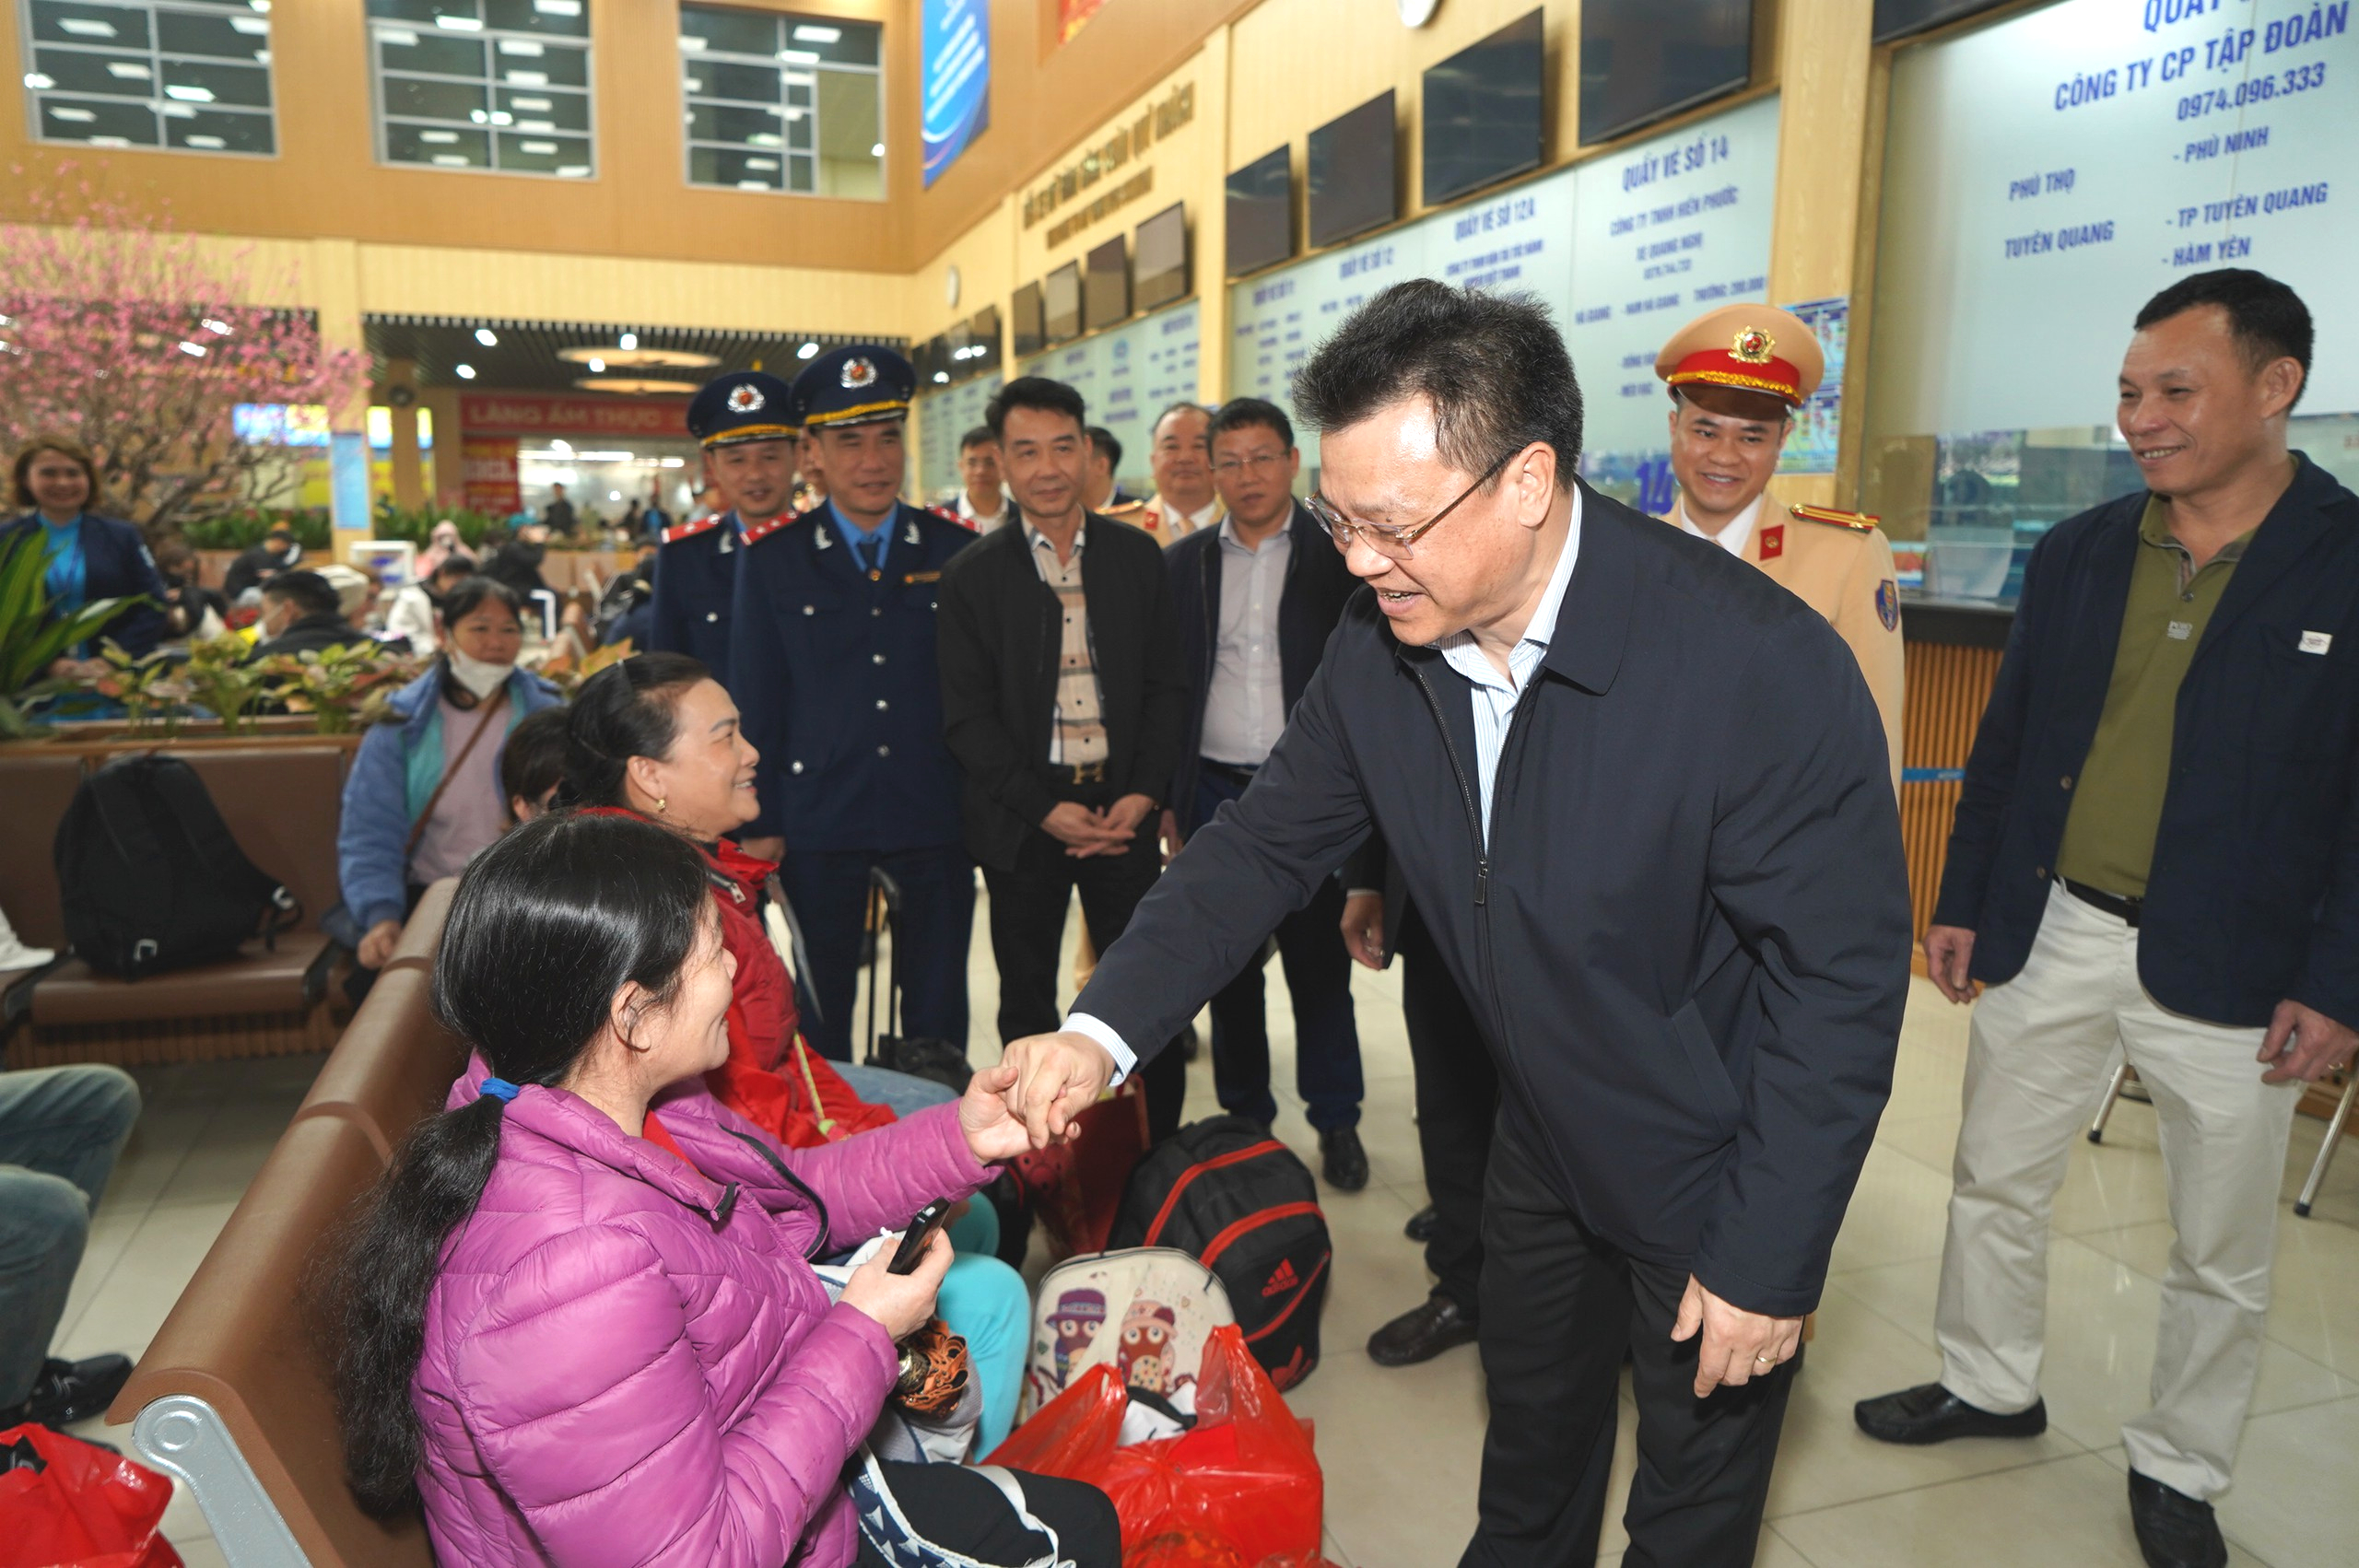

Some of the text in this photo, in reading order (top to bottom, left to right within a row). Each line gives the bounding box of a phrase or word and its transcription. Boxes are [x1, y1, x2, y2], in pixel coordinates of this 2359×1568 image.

[2054, 0, 2349, 111] CÔNG TY CP TẬP ĐOÀN
[2177, 62, 2325, 122] 0974.096.333
[1711, 135, 1730, 164] 14
[2224, 125, 2270, 154] NINH
[2178, 207, 2198, 228] TP
[2264, 182, 2329, 214] QUANG
[2058, 220, 2114, 251] QUANG
[1636, 461, 1672, 515] 14
